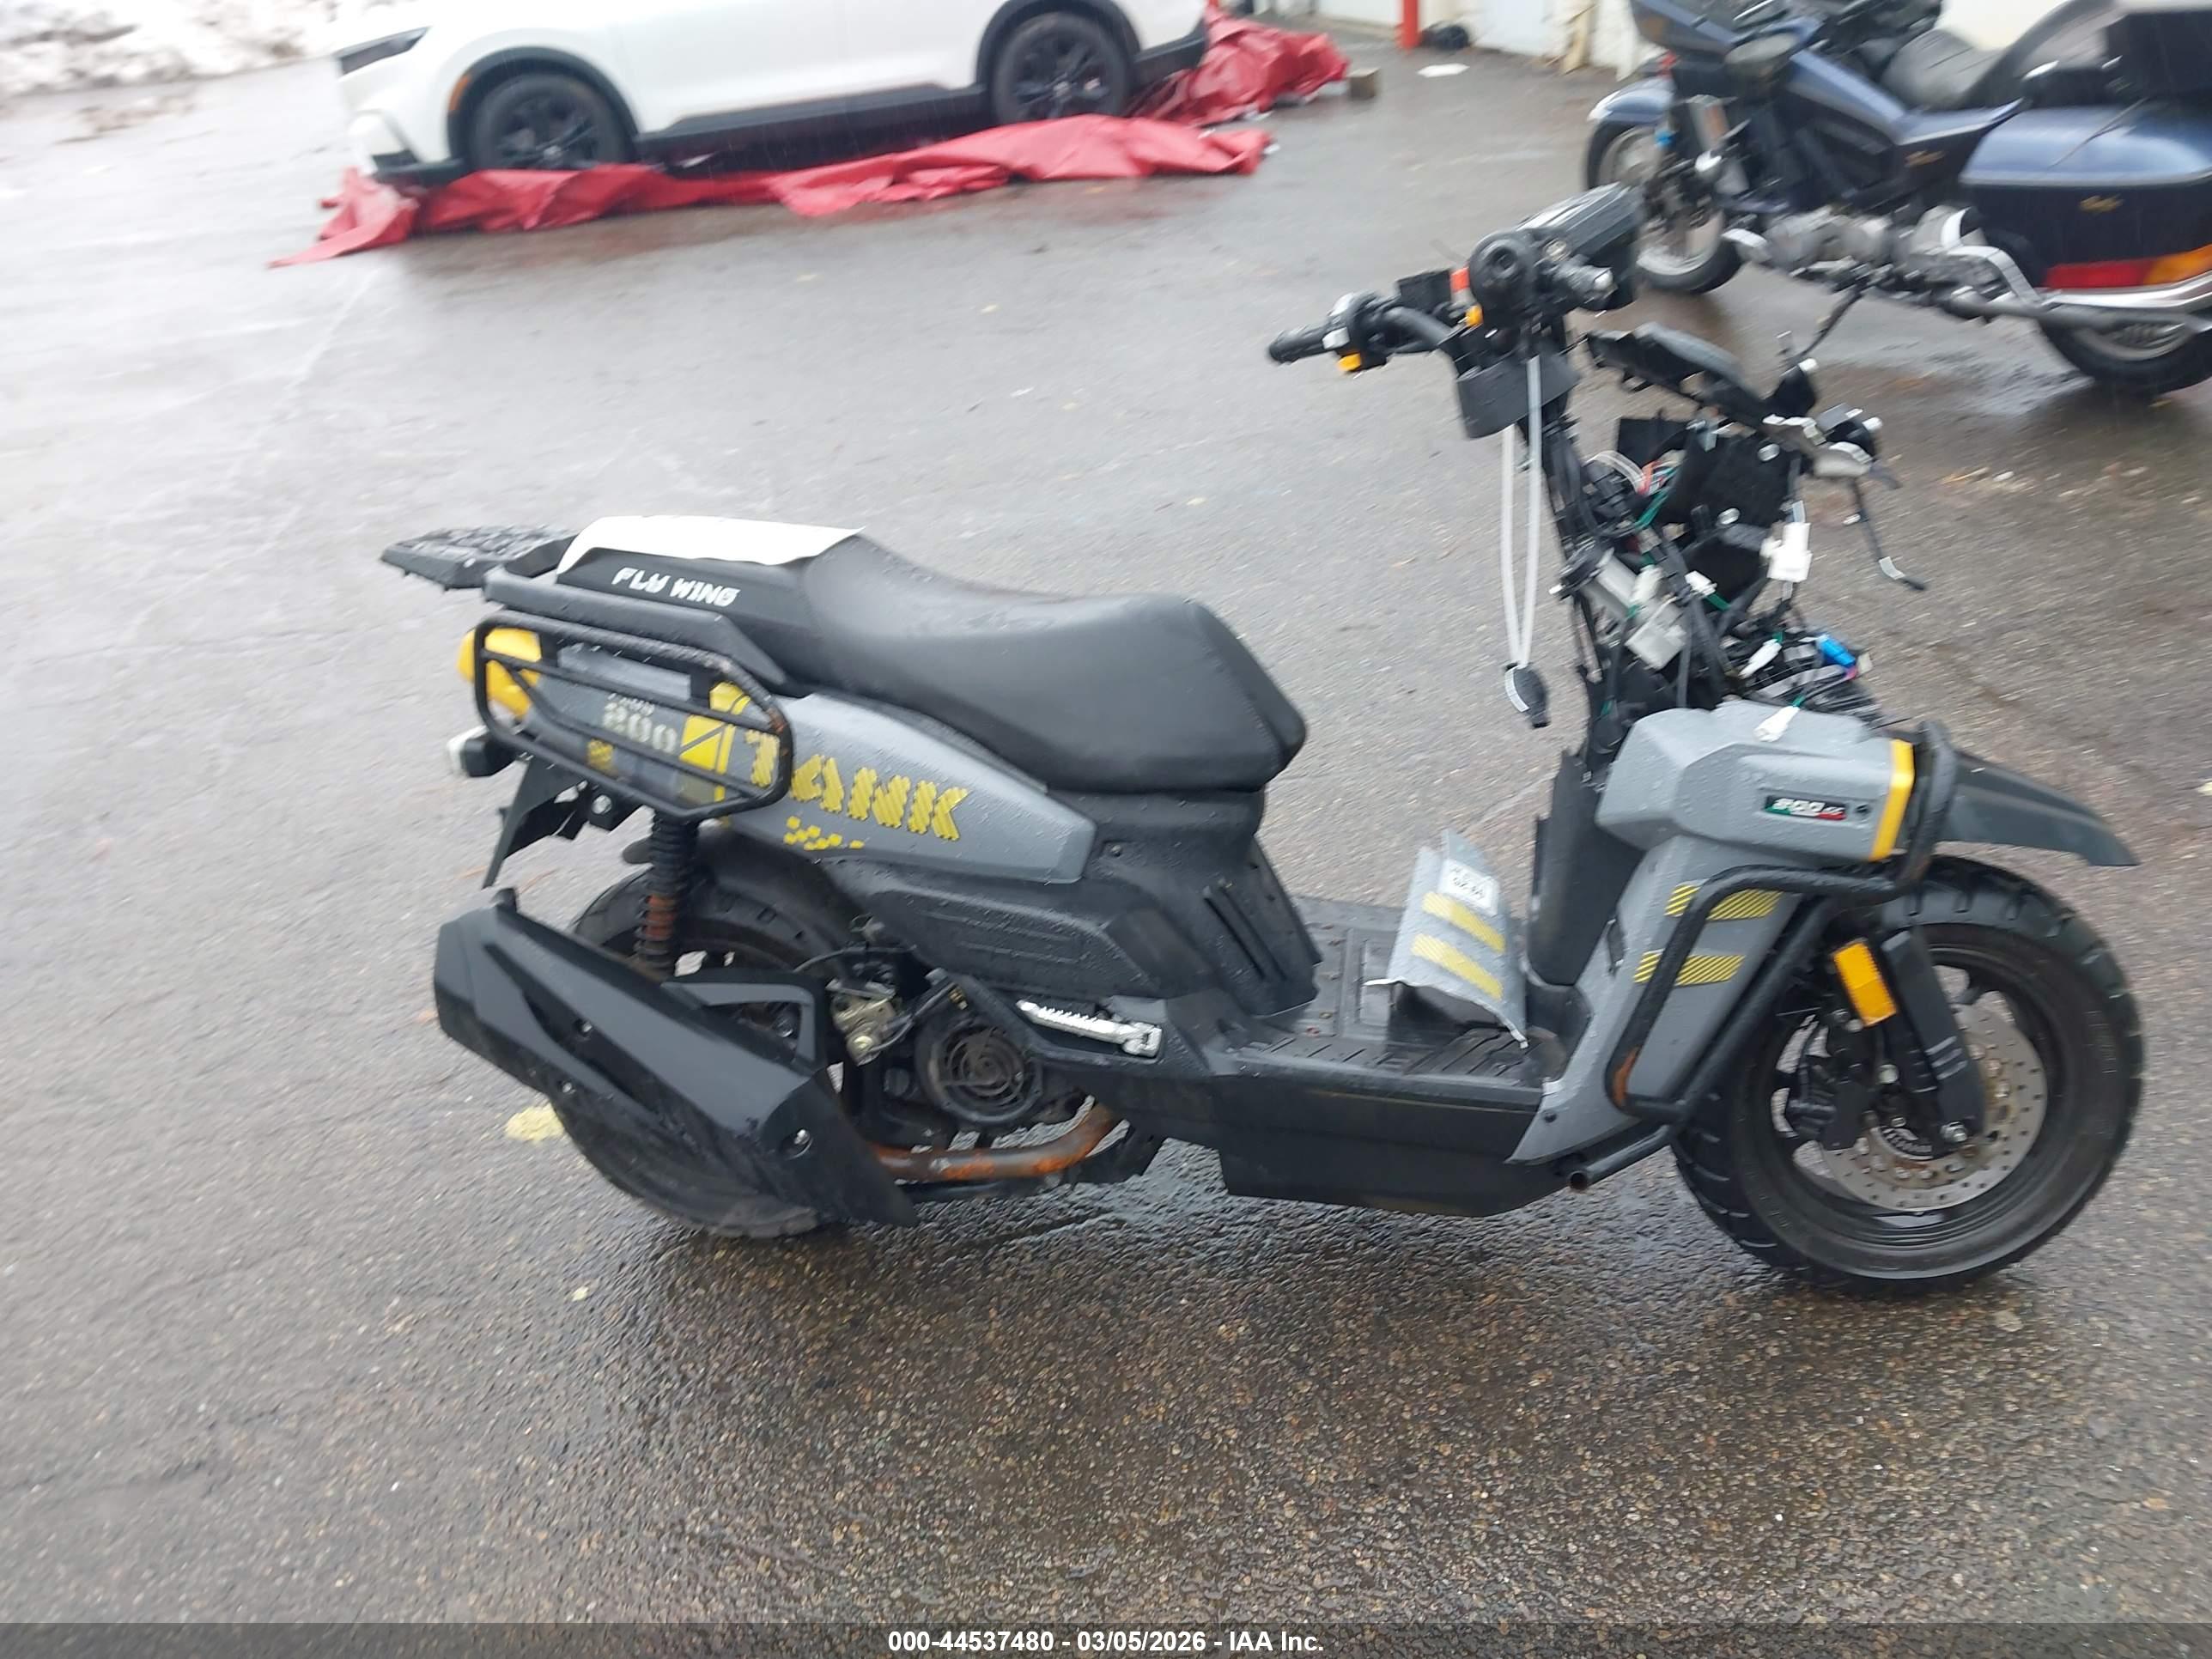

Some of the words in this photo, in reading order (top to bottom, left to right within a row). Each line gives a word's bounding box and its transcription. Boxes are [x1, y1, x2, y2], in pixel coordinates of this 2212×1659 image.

[611, 567, 672, 593] FLY
[669, 577, 741, 607] WING
[744, 729, 970, 842] TANK
